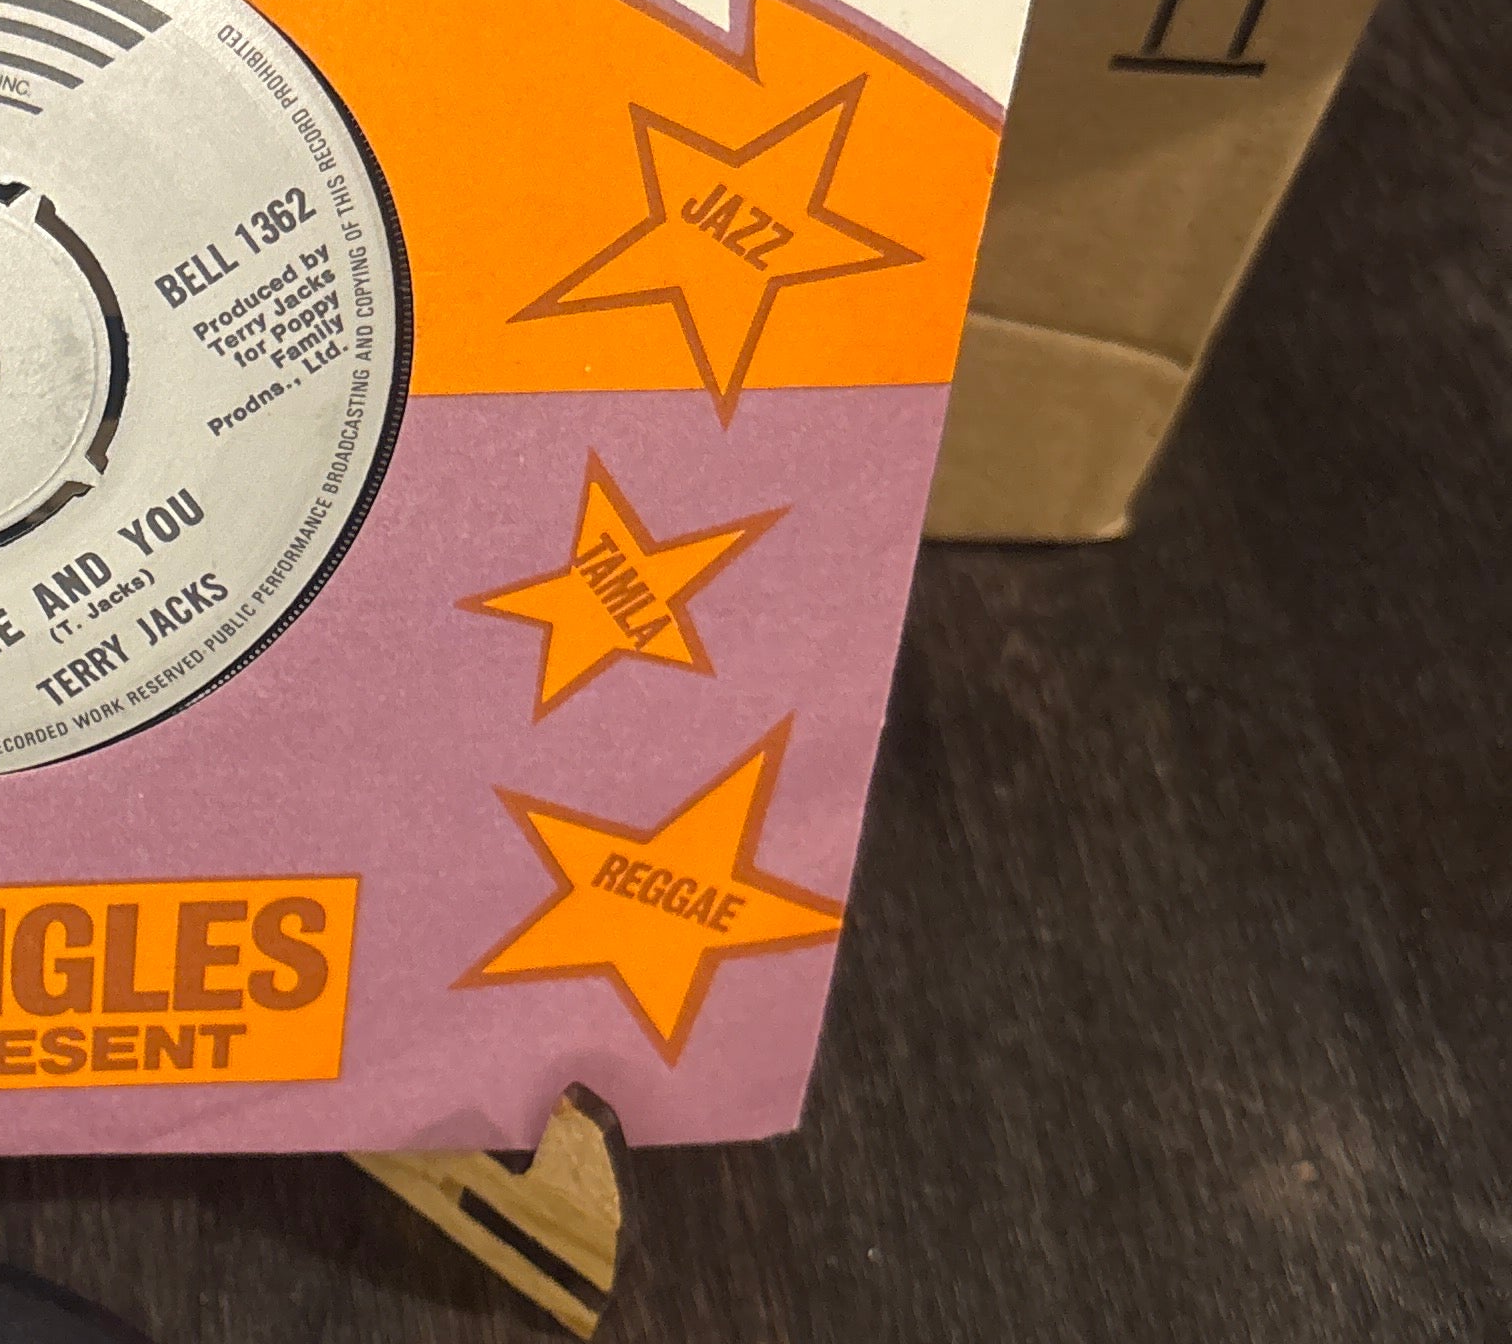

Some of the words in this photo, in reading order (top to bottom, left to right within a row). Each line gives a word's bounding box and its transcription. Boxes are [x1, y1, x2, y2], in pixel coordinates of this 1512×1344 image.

[217, 24, 299, 110] PROHIBITED
[291, 108, 337, 173] RECORD
[326, 174, 354, 218] THIS
[341, 220, 363, 242] OF
[681, 183, 794, 271] JAZZ
[154, 243, 240, 309] BELL
[234, 187, 317, 255] 1362
[348, 245, 374, 318] COPYING
[192, 263, 299, 342] Produced
[298, 243, 330, 271] by
[206, 312, 267, 357] Terry
[272, 268, 337, 318] Jacks
[233, 339, 268, 368] for
[269, 289, 340, 344] Poppy
[269, 312, 345, 370] Family
[356, 324, 374, 361] AND
[206, 377, 302, 437] Prodns.,
[301, 339, 349, 375] Ltd.
[322, 368, 370, 495] BROADCASTING
[31, 551, 113, 620] AND
[116, 488, 205, 556] YOU
[251, 497, 333, 605] PERFORMANCE
[572, 532, 672, 652] TAMLA
[35, 634, 130, 707] TERRY
[136, 572, 229, 646] JACKS
[49, 619, 83, 644] (T.
[87, 568, 155, 620] Jacks)
[203, 603, 257, 653] PUBLIC
[72, 698, 125, 729] WORK
[591, 852, 745, 933] REGGAE
